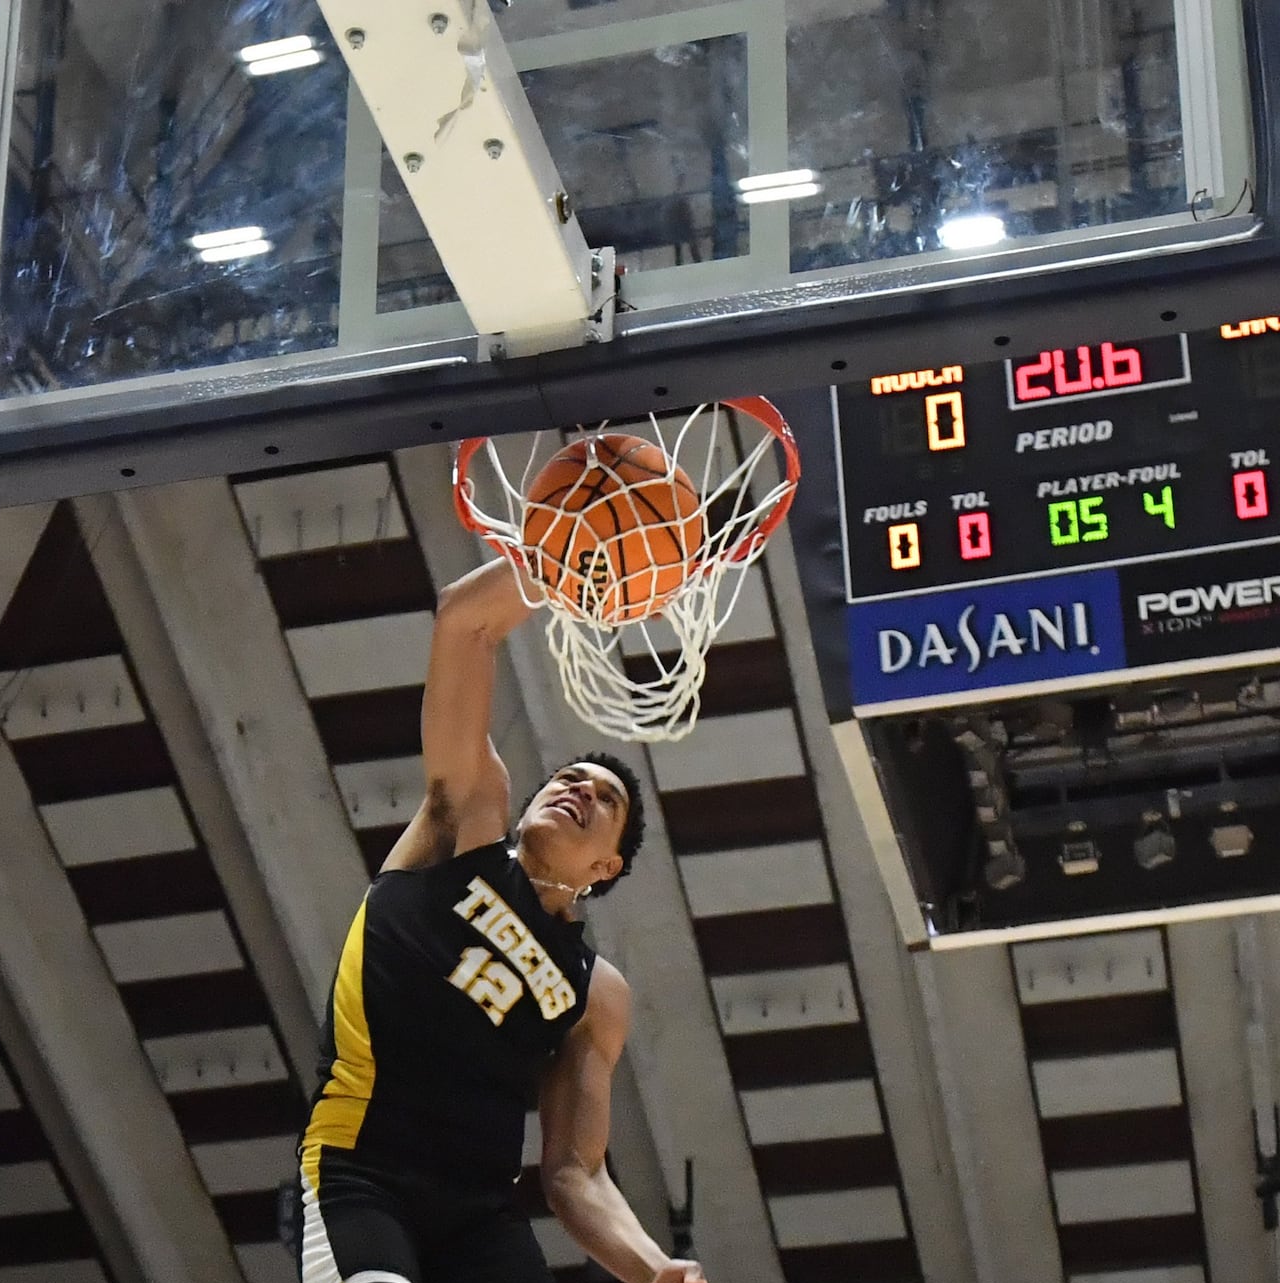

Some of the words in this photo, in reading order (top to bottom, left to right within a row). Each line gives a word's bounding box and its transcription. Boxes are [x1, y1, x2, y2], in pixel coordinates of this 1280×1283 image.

[925, 391, 966, 451] 0
[1015, 420, 1113, 453] PERIOD
[1037, 462, 1181, 498] PLAYER-FOUL
[1229, 448, 1270, 470] TOL
[863, 499, 928, 525] FOULS
[950, 490, 990, 511] TOL
[1143, 486, 1176, 529] 4
[1233, 470, 1268, 520] 0
[958, 512, 992, 560] 0
[1048, 496, 1109, 547] 05
[888, 523, 920, 570] 0
[879, 602, 1089, 673] DASANI
[452, 875, 577, 1021] TIGERS
[444, 946, 524, 1027] 12
